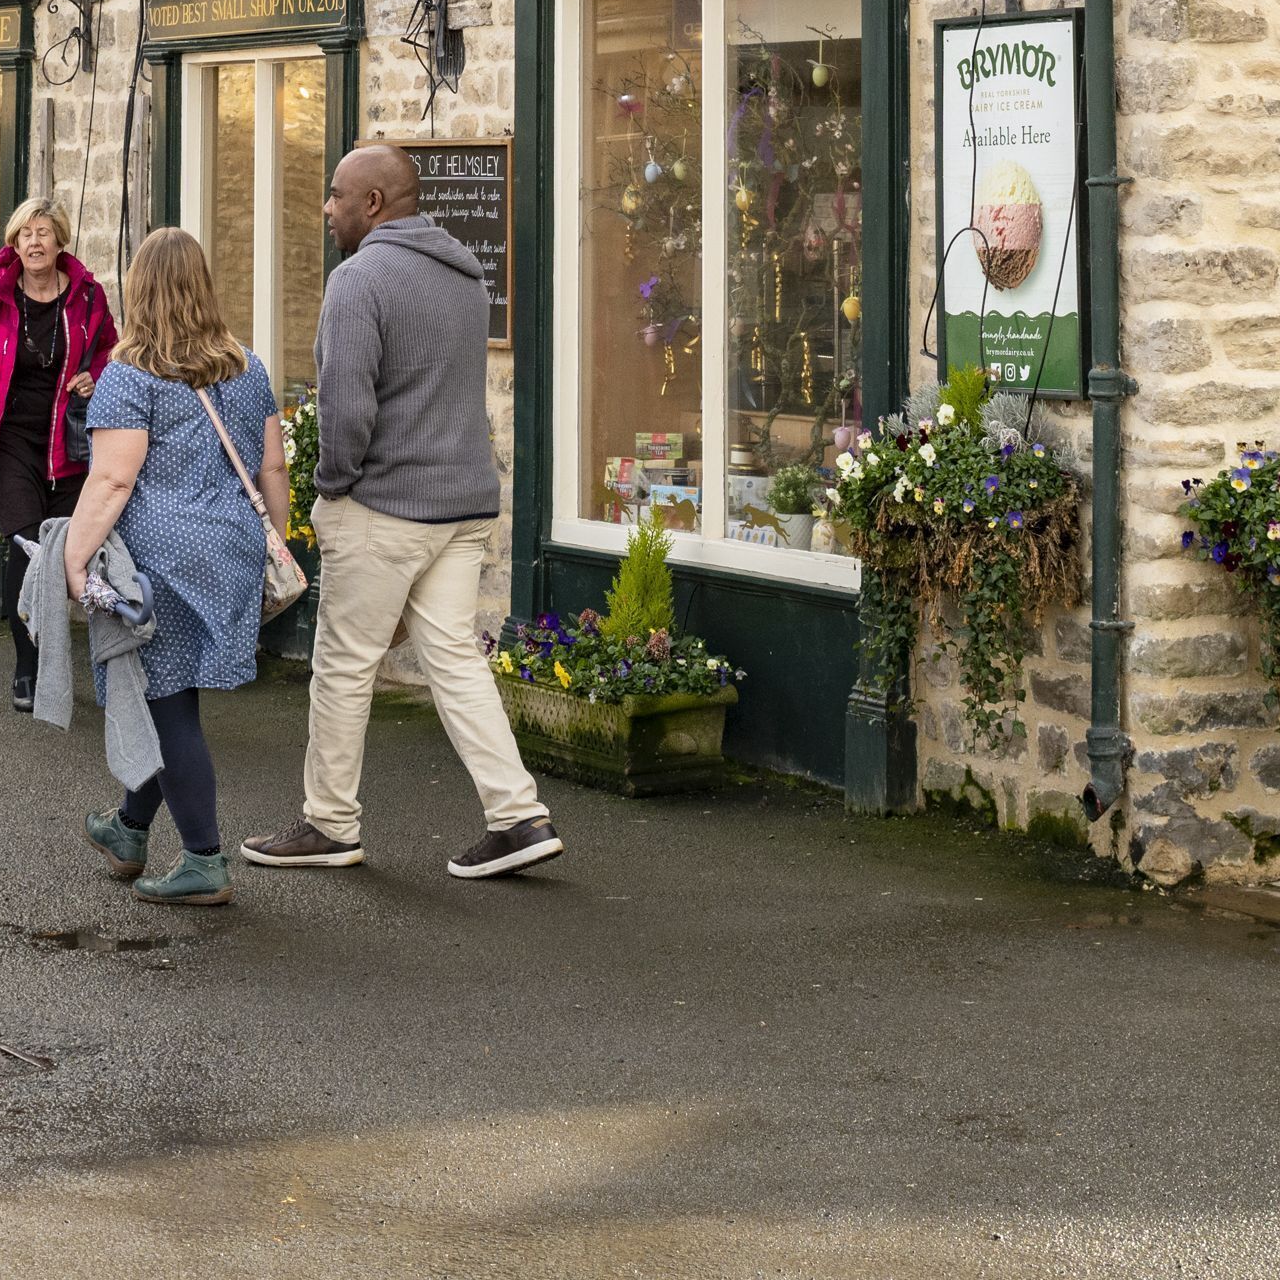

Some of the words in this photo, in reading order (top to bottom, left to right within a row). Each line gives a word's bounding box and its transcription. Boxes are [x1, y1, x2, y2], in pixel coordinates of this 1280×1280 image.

[149, 4, 179, 27] VOTED
[956, 40, 1057, 91] BRYMOR
[996, 88, 1031, 97] YORKSHIRE
[996, 101, 1010, 111] ICE
[1013, 99, 1044, 110] CREAM
[963, 125, 1017, 148] Available
[1021, 124, 1051, 145] Here
[428, 154, 442, 175] OF
[446, 154, 500, 177] HELMSLEY
[978, 325, 1006, 345] ovingly
[985, 346, 1035, 357] brymordairy.co.uk
